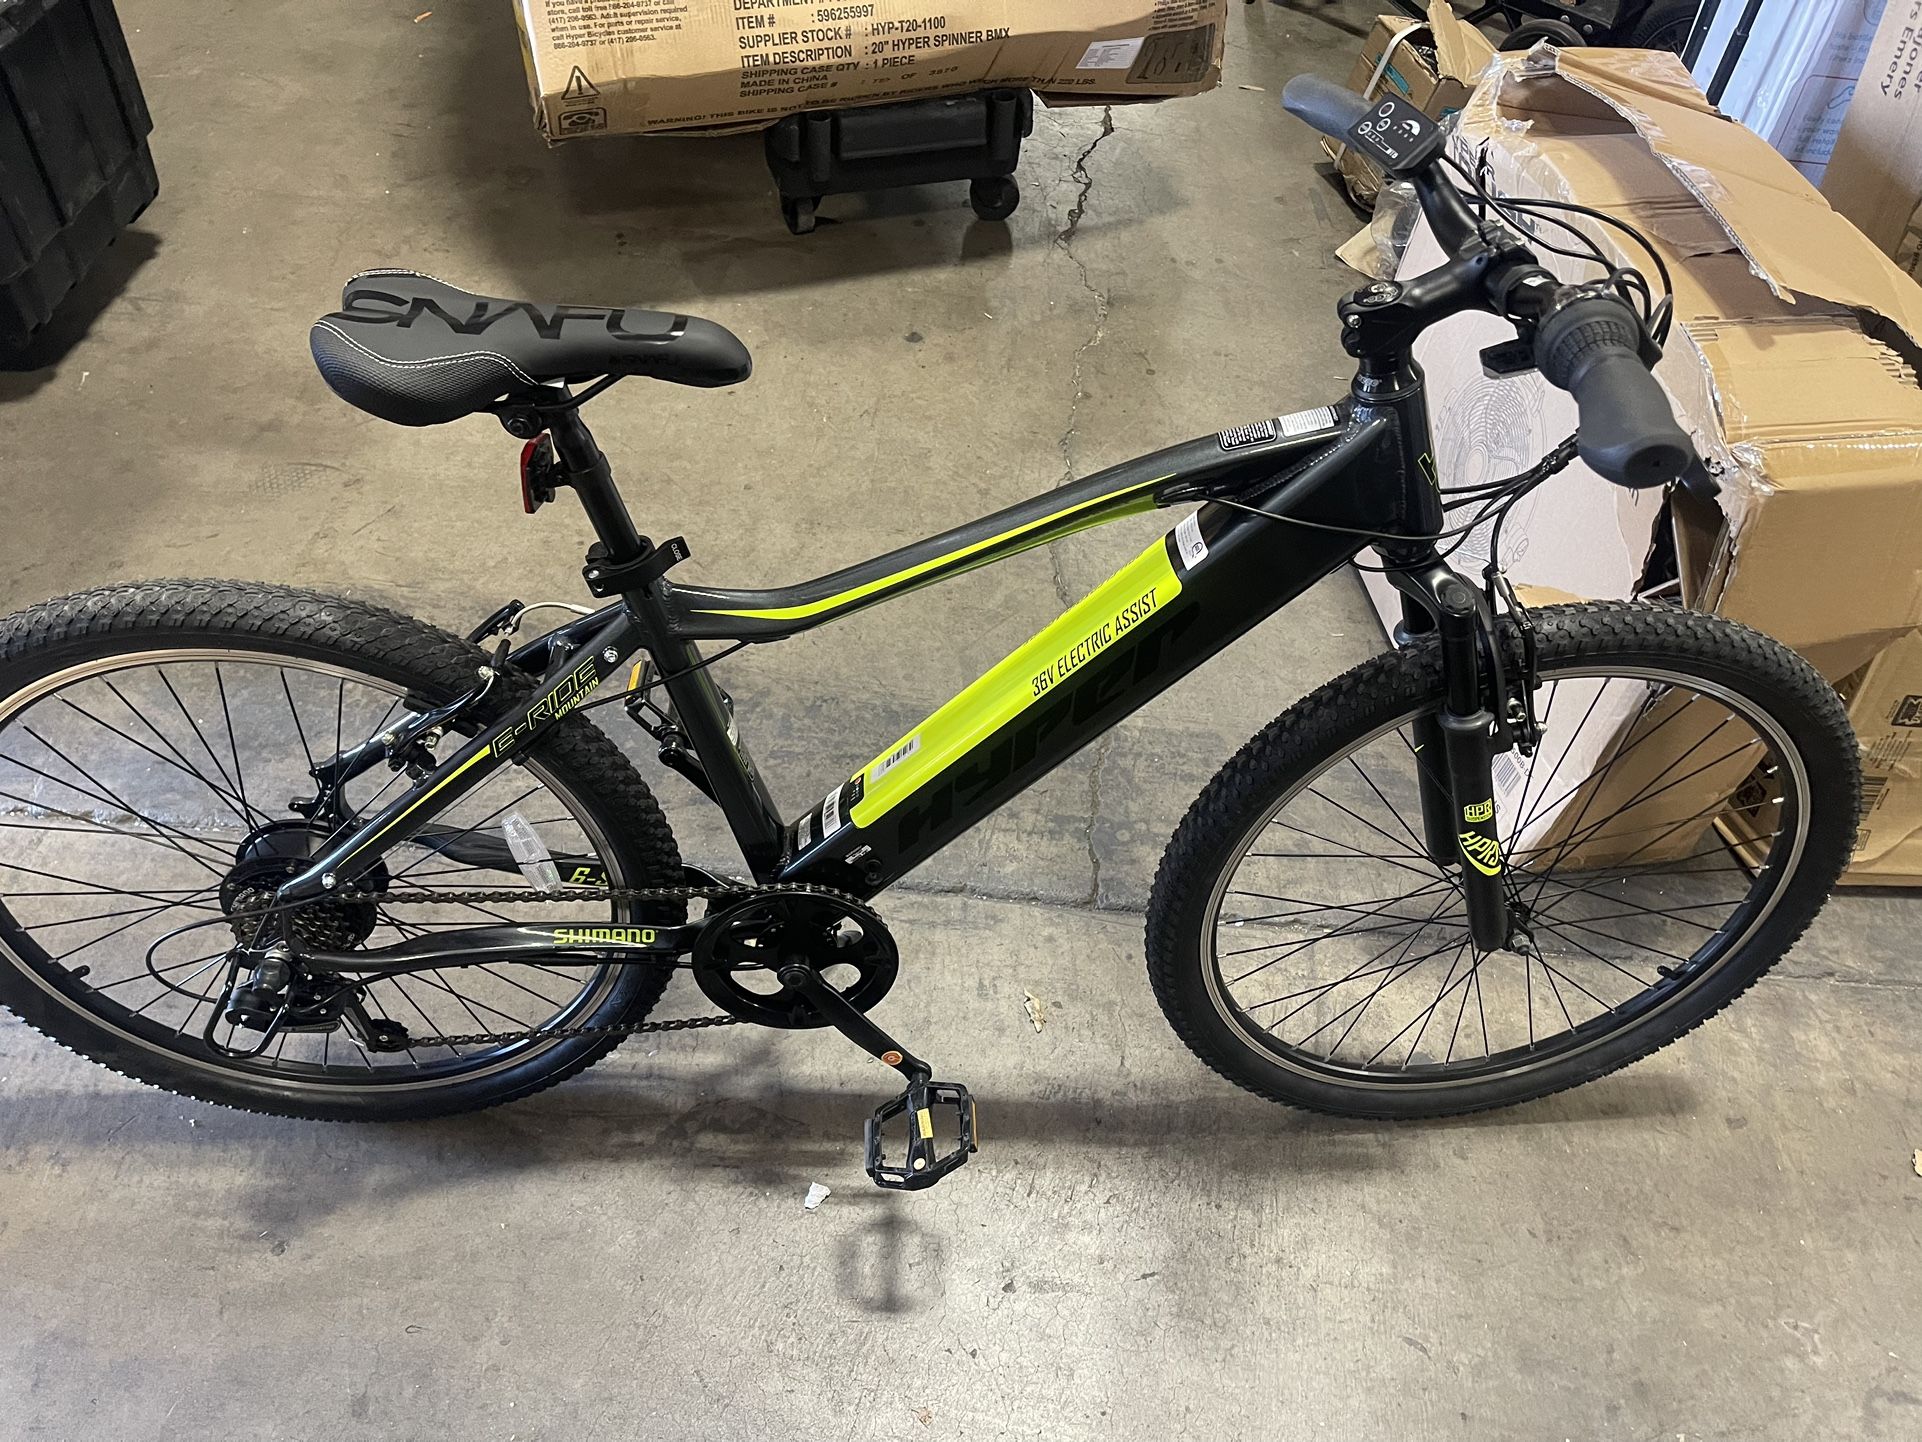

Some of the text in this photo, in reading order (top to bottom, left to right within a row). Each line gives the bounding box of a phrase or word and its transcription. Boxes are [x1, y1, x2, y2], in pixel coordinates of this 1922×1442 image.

[736, 15, 765, 30] ITEM
[767, 14, 776, 27] #
[816, 5, 875, 23] 596255997
[739, 31, 799, 50] SUPPLIER
[801, 26, 843, 45] STOCK
[845, 25, 852, 40] #
[871, 15, 946, 36] HYP-T20-1100
[741, 52, 771, 68] ITEM
[773, 45, 852, 66] DESCRIPTION
[892, 35, 931, 52] HYPER
[933, 30, 984, 47] SPINNER
[986, 27, 1010, 41] BMX
[1881, 26, 1915, 96] Emery
[740, 74, 829, 89] MADE IN CHINA
[741, 67, 798, 80] SHIPPING
[800, 64, 834, 75] CASE
[836, 61, 860, 73] QTY
[881, 55, 915, 69] PIECE
[739, 86, 795, 98] SHIPPING
[797, 82, 827, 94] CASE
[647, 115, 706, 126] WARNING!
[708, 111, 734, 119] THIS
[737, 108, 764, 116] BIKE
[331, 289, 687, 342] SNAFU
[1031, 587, 1157, 697] 36V ELECTRIC ASSIST
[492, 655, 597, 758] E-RIDE
[554, 676, 599, 721] MOUNTAIN
[553, 928, 656, 944] SHIMANO
